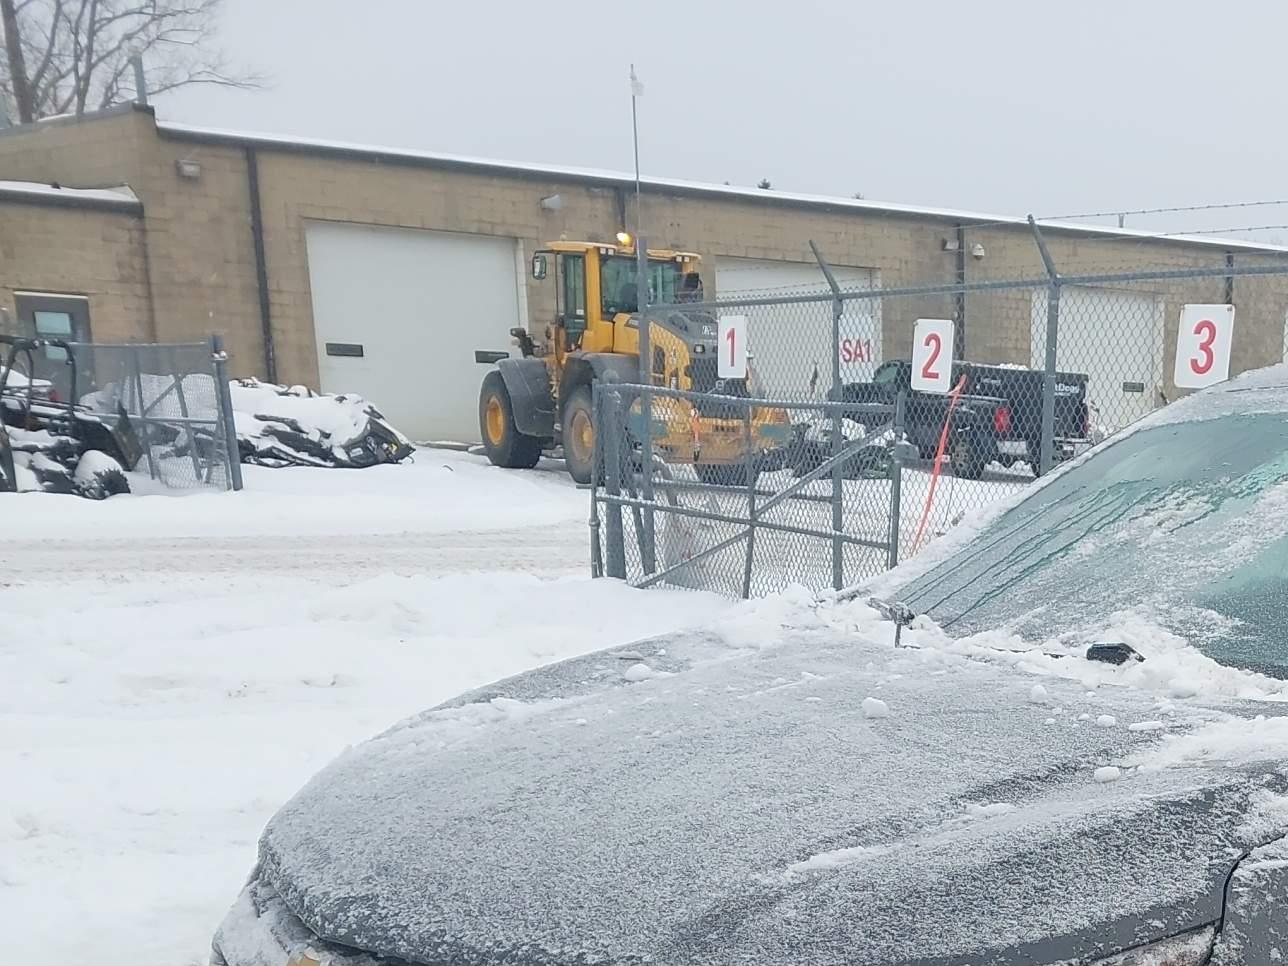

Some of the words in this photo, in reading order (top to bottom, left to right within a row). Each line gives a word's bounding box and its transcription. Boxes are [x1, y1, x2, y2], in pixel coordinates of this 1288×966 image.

[726, 327, 736, 367] 1
[842, 338, 872, 364] SA1
[921, 332, 942, 380] 2
[1190, 318, 1217, 375] 3
